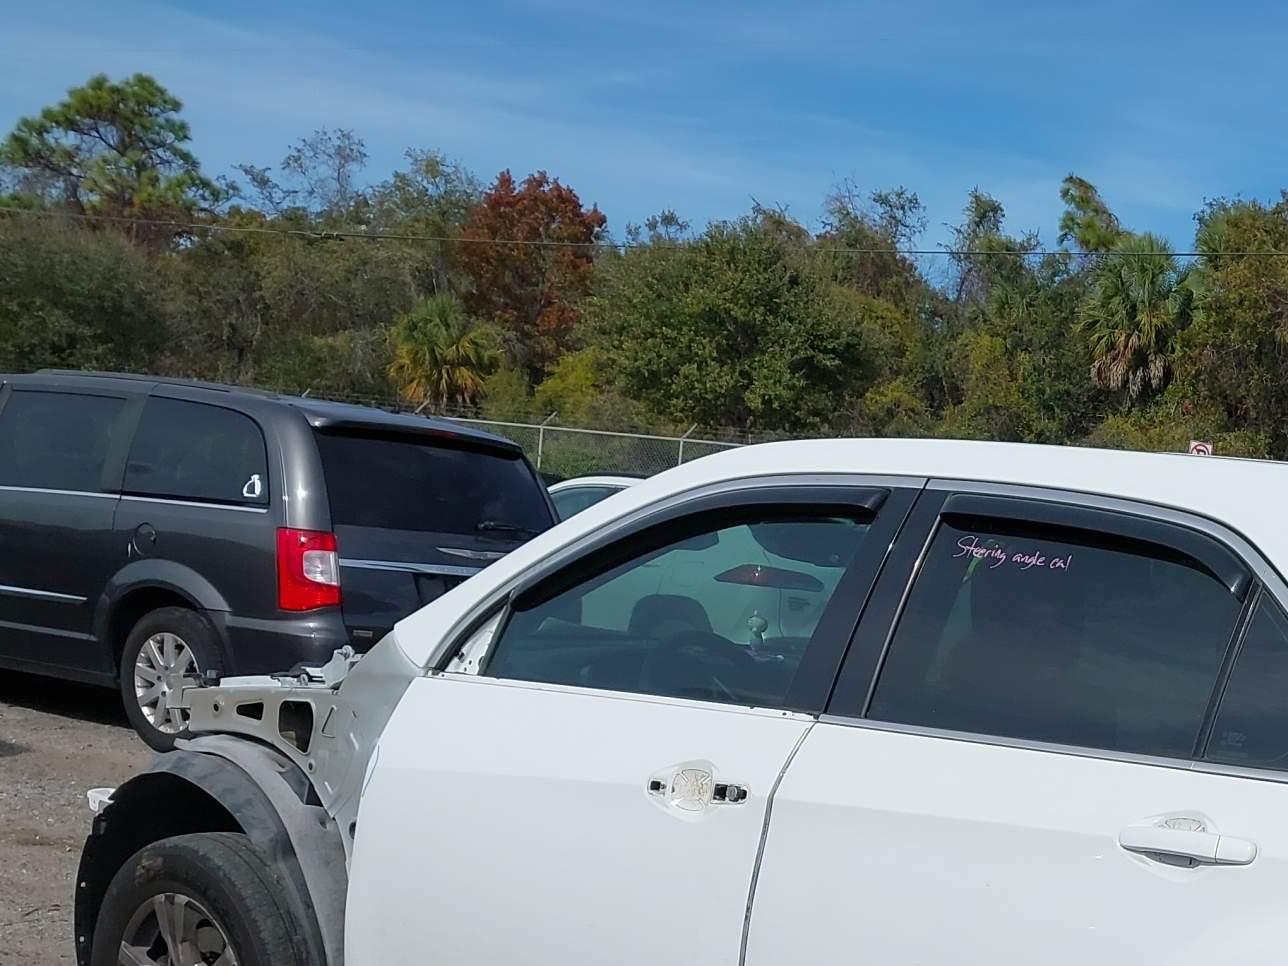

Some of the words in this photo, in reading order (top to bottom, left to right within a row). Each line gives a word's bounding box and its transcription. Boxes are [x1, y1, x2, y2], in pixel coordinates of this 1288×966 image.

[953, 536, 1006, 568] Steering
[1012, 551, 1045, 570] angle
[1050, 555, 1073, 572] cal
